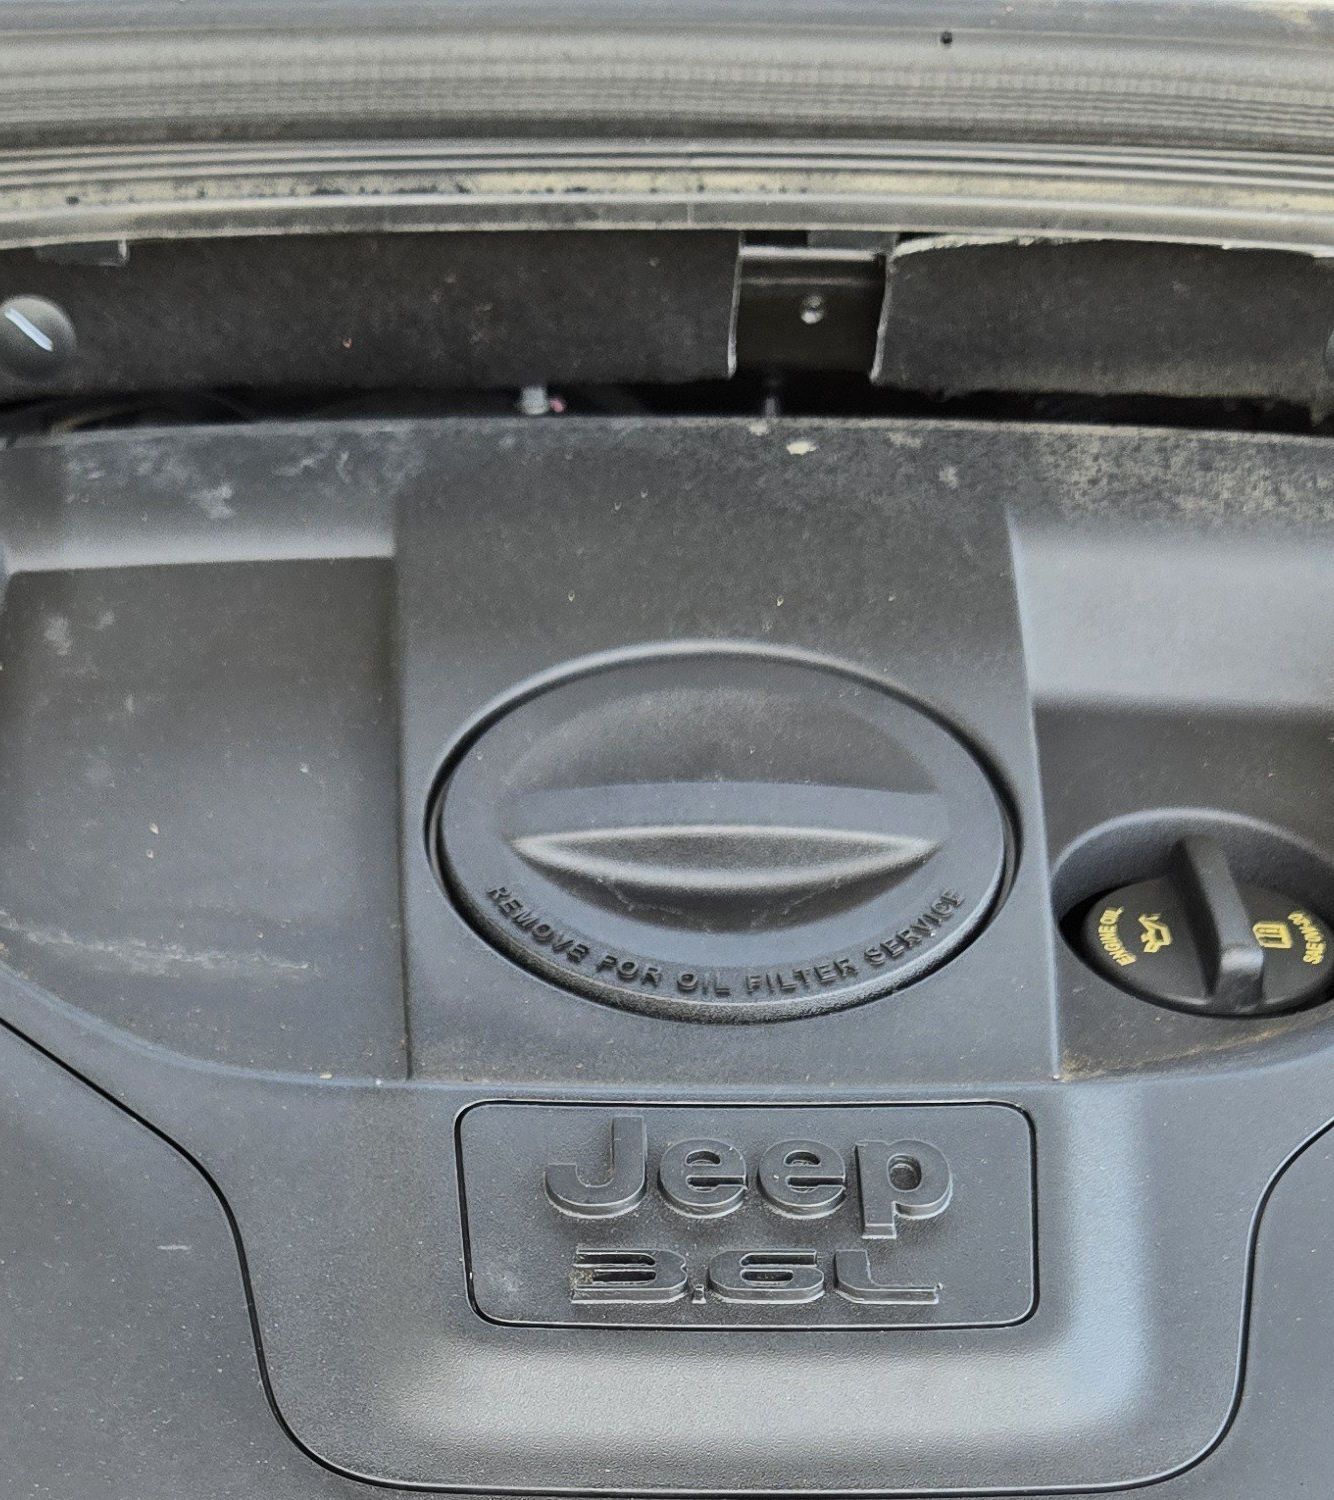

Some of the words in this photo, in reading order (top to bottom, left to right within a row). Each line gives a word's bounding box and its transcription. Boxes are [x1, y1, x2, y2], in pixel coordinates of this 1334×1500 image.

[485, 885, 589, 966] REMOVE
[595, 952, 663, 986] FOR
[676, 969, 732, 996] OIL
[746, 956, 858, 995] FILTER
[864, 887, 966, 967] SERVICE
[1098, 924, 1138, 967] ENGINE
[1099, 906, 1125, 926] OIL
[543, 1114, 954, 1240] Jeep
[570, 1246, 943, 1305] 3.6L
